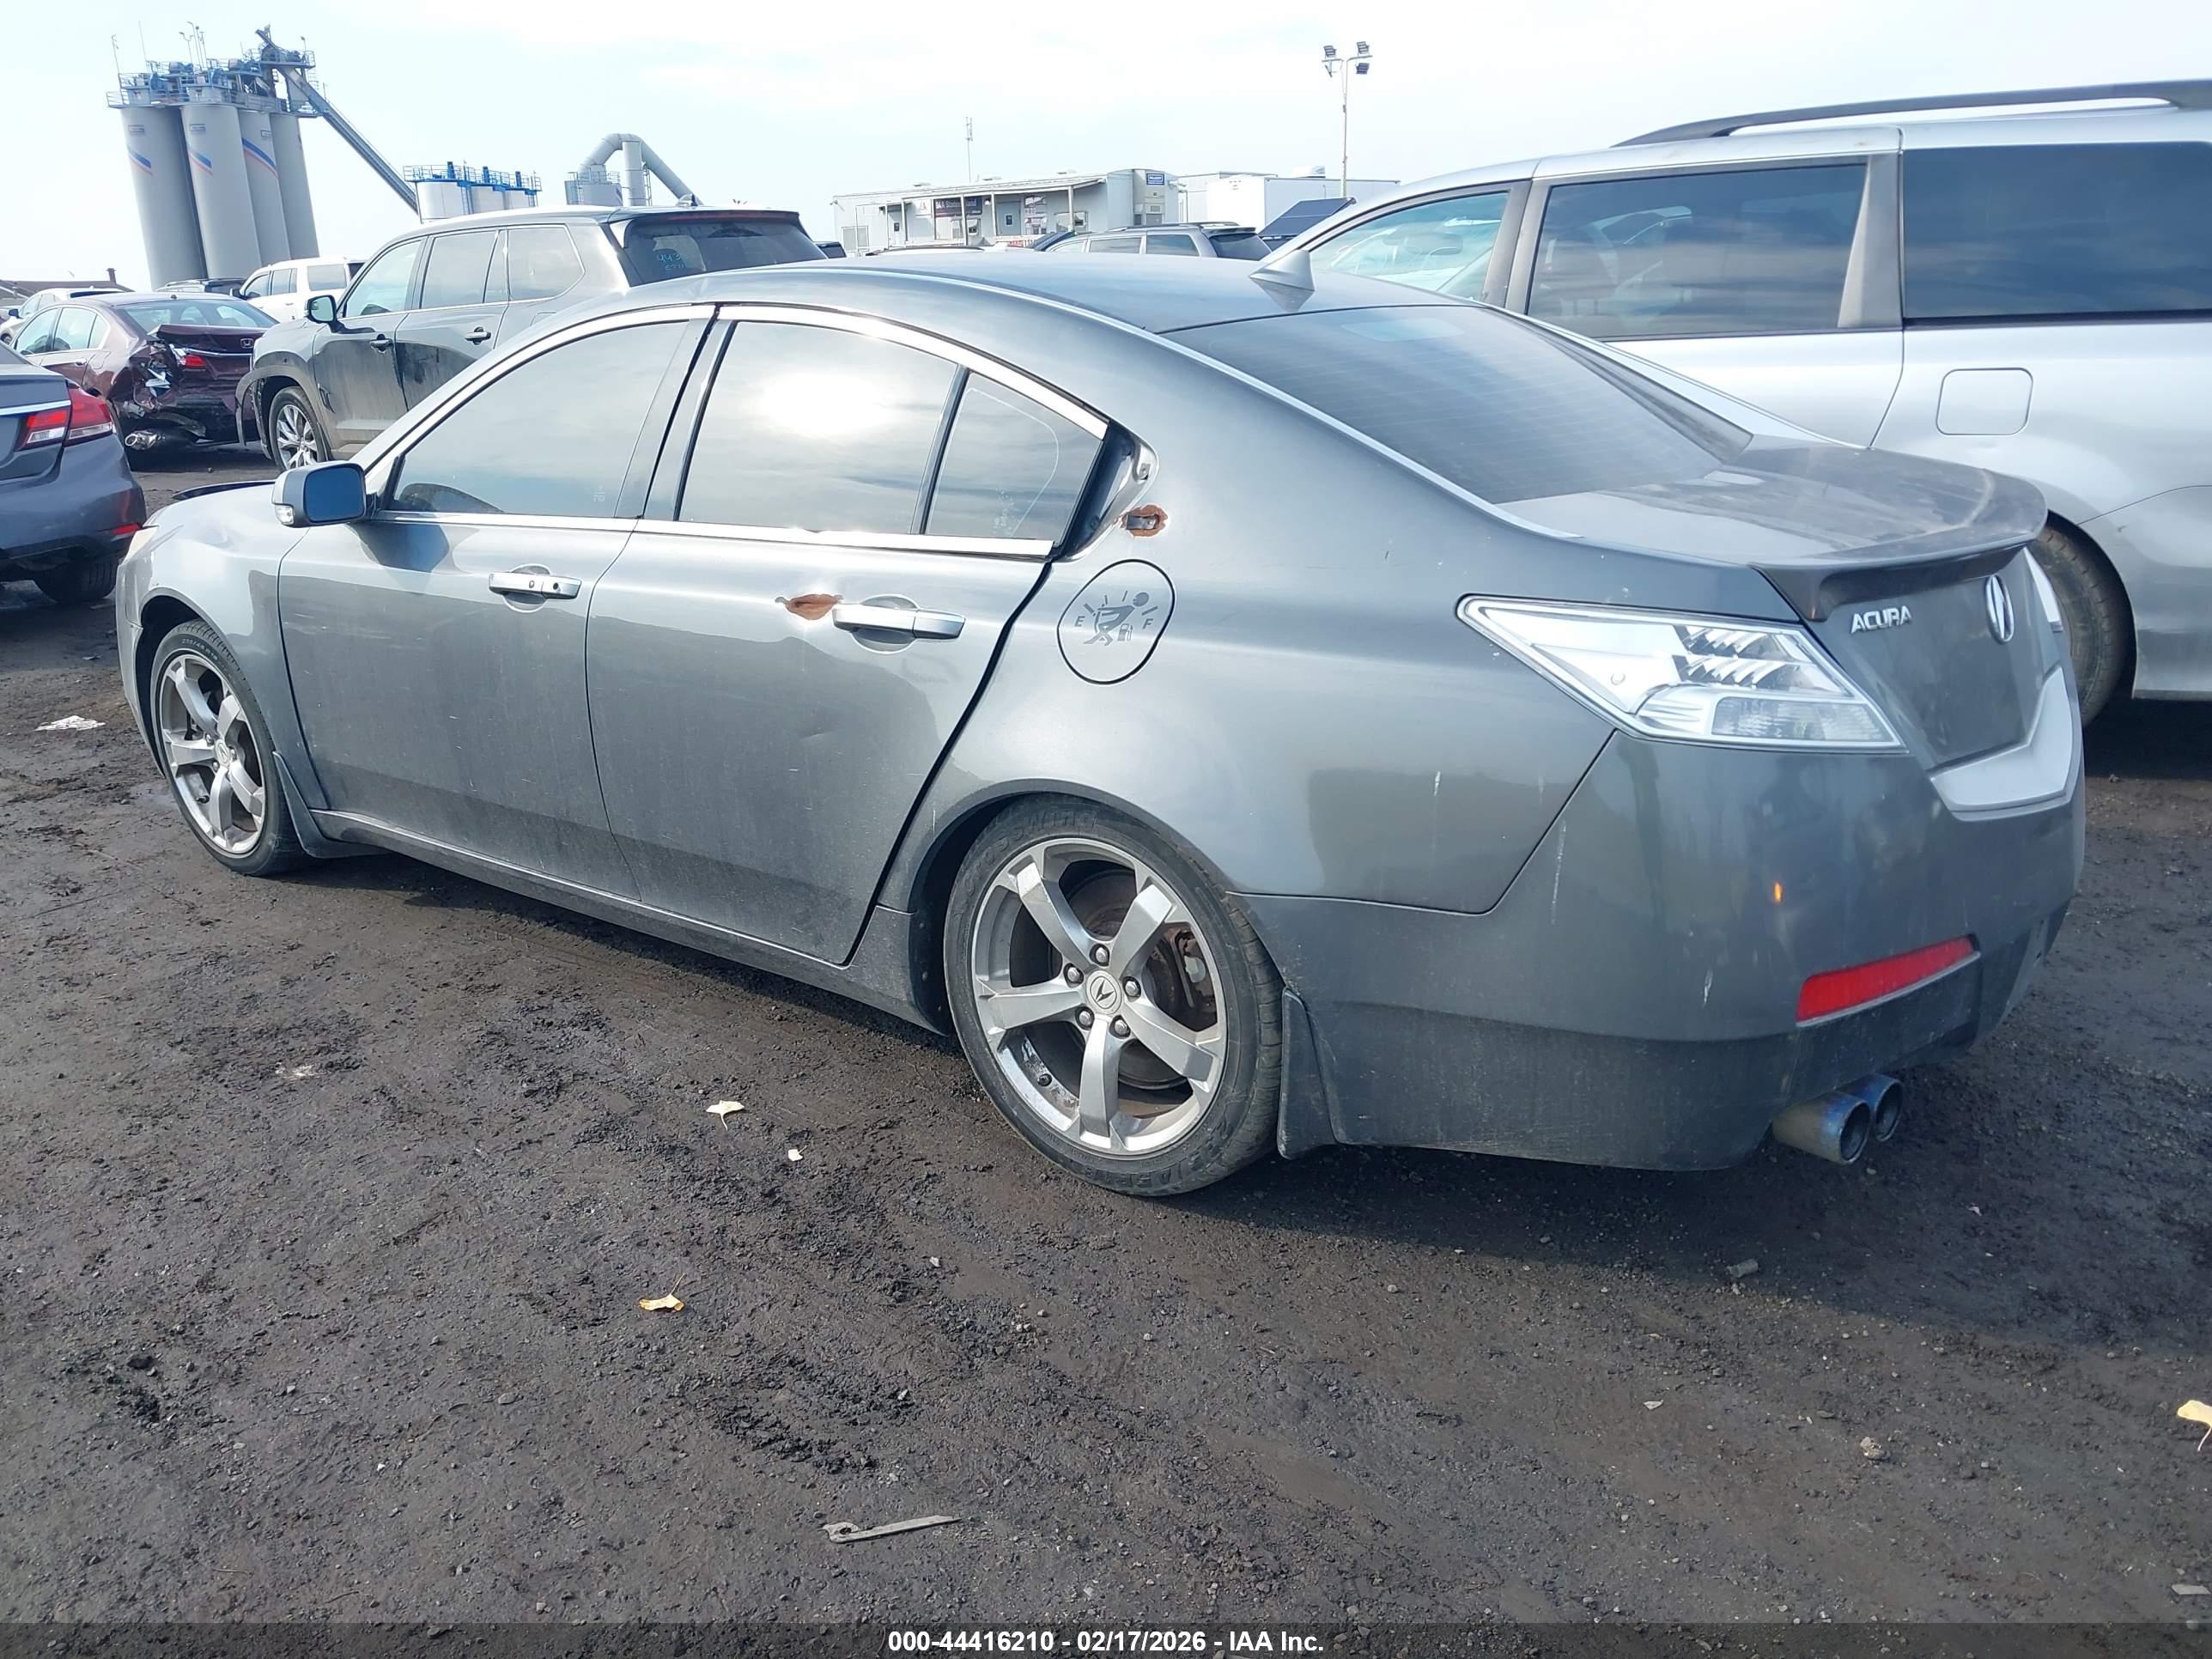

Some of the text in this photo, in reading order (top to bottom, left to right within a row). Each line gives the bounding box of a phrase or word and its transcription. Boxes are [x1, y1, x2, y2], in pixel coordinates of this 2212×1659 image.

[1074, 616, 1085, 627] E
[1143, 618, 1154, 629] F
[1850, 605, 1911, 633] ACURA
